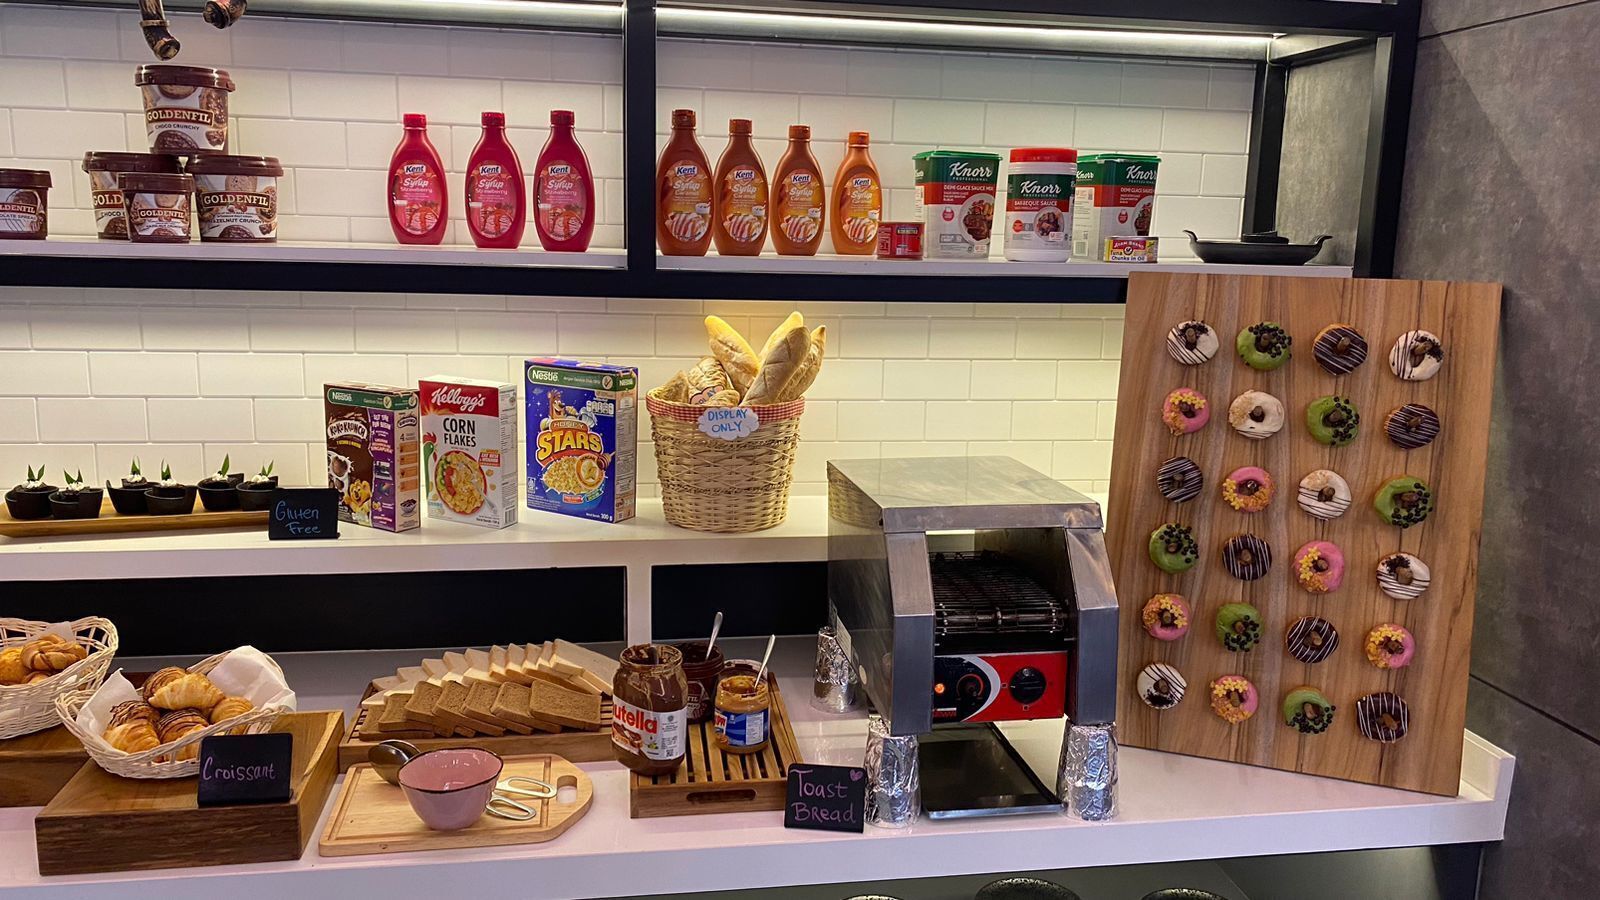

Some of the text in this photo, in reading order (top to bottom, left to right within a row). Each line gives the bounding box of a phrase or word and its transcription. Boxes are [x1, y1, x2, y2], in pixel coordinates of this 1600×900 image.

[146, 110, 211, 123] GOLDENFIL
[405, 165, 424, 173] Kent
[480, 166, 500, 174] Kent
[550, 166, 569, 174] Kent
[676, 167, 696, 175] Kent
[735, 171, 753, 179] Kent
[949, 162, 993, 178] Knorr
[403, 178, 429, 188] Syrup
[478, 179, 504, 189] Syrup
[547, 180, 573, 190] Syrup
[673, 181, 701, 192] Syrup
[731, 184, 757, 194] Syrup
[1020, 180, 1061, 194] Knorr
[789, 188, 813, 198] Syrup
[850, 191, 873, 200] Syrup
[203, 194, 269, 206] GOLDENFIL
[140, 210, 185, 219] GOLDENFIL
[431, 385, 486, 412] Kellogg's
[707, 409, 748, 421] DISPLAY
[442, 417, 476, 435] CORN
[711, 420, 743, 432] ONLY
[443, 433, 477, 447] FLAKES
[536, 430, 603, 460] STARS
[275, 500, 319, 521] Gluten
[285, 521, 321, 534] Free
[612, 703, 658, 735] utella
[202, 756, 276, 781] Croissant
[789, 768, 848, 798] Toast
